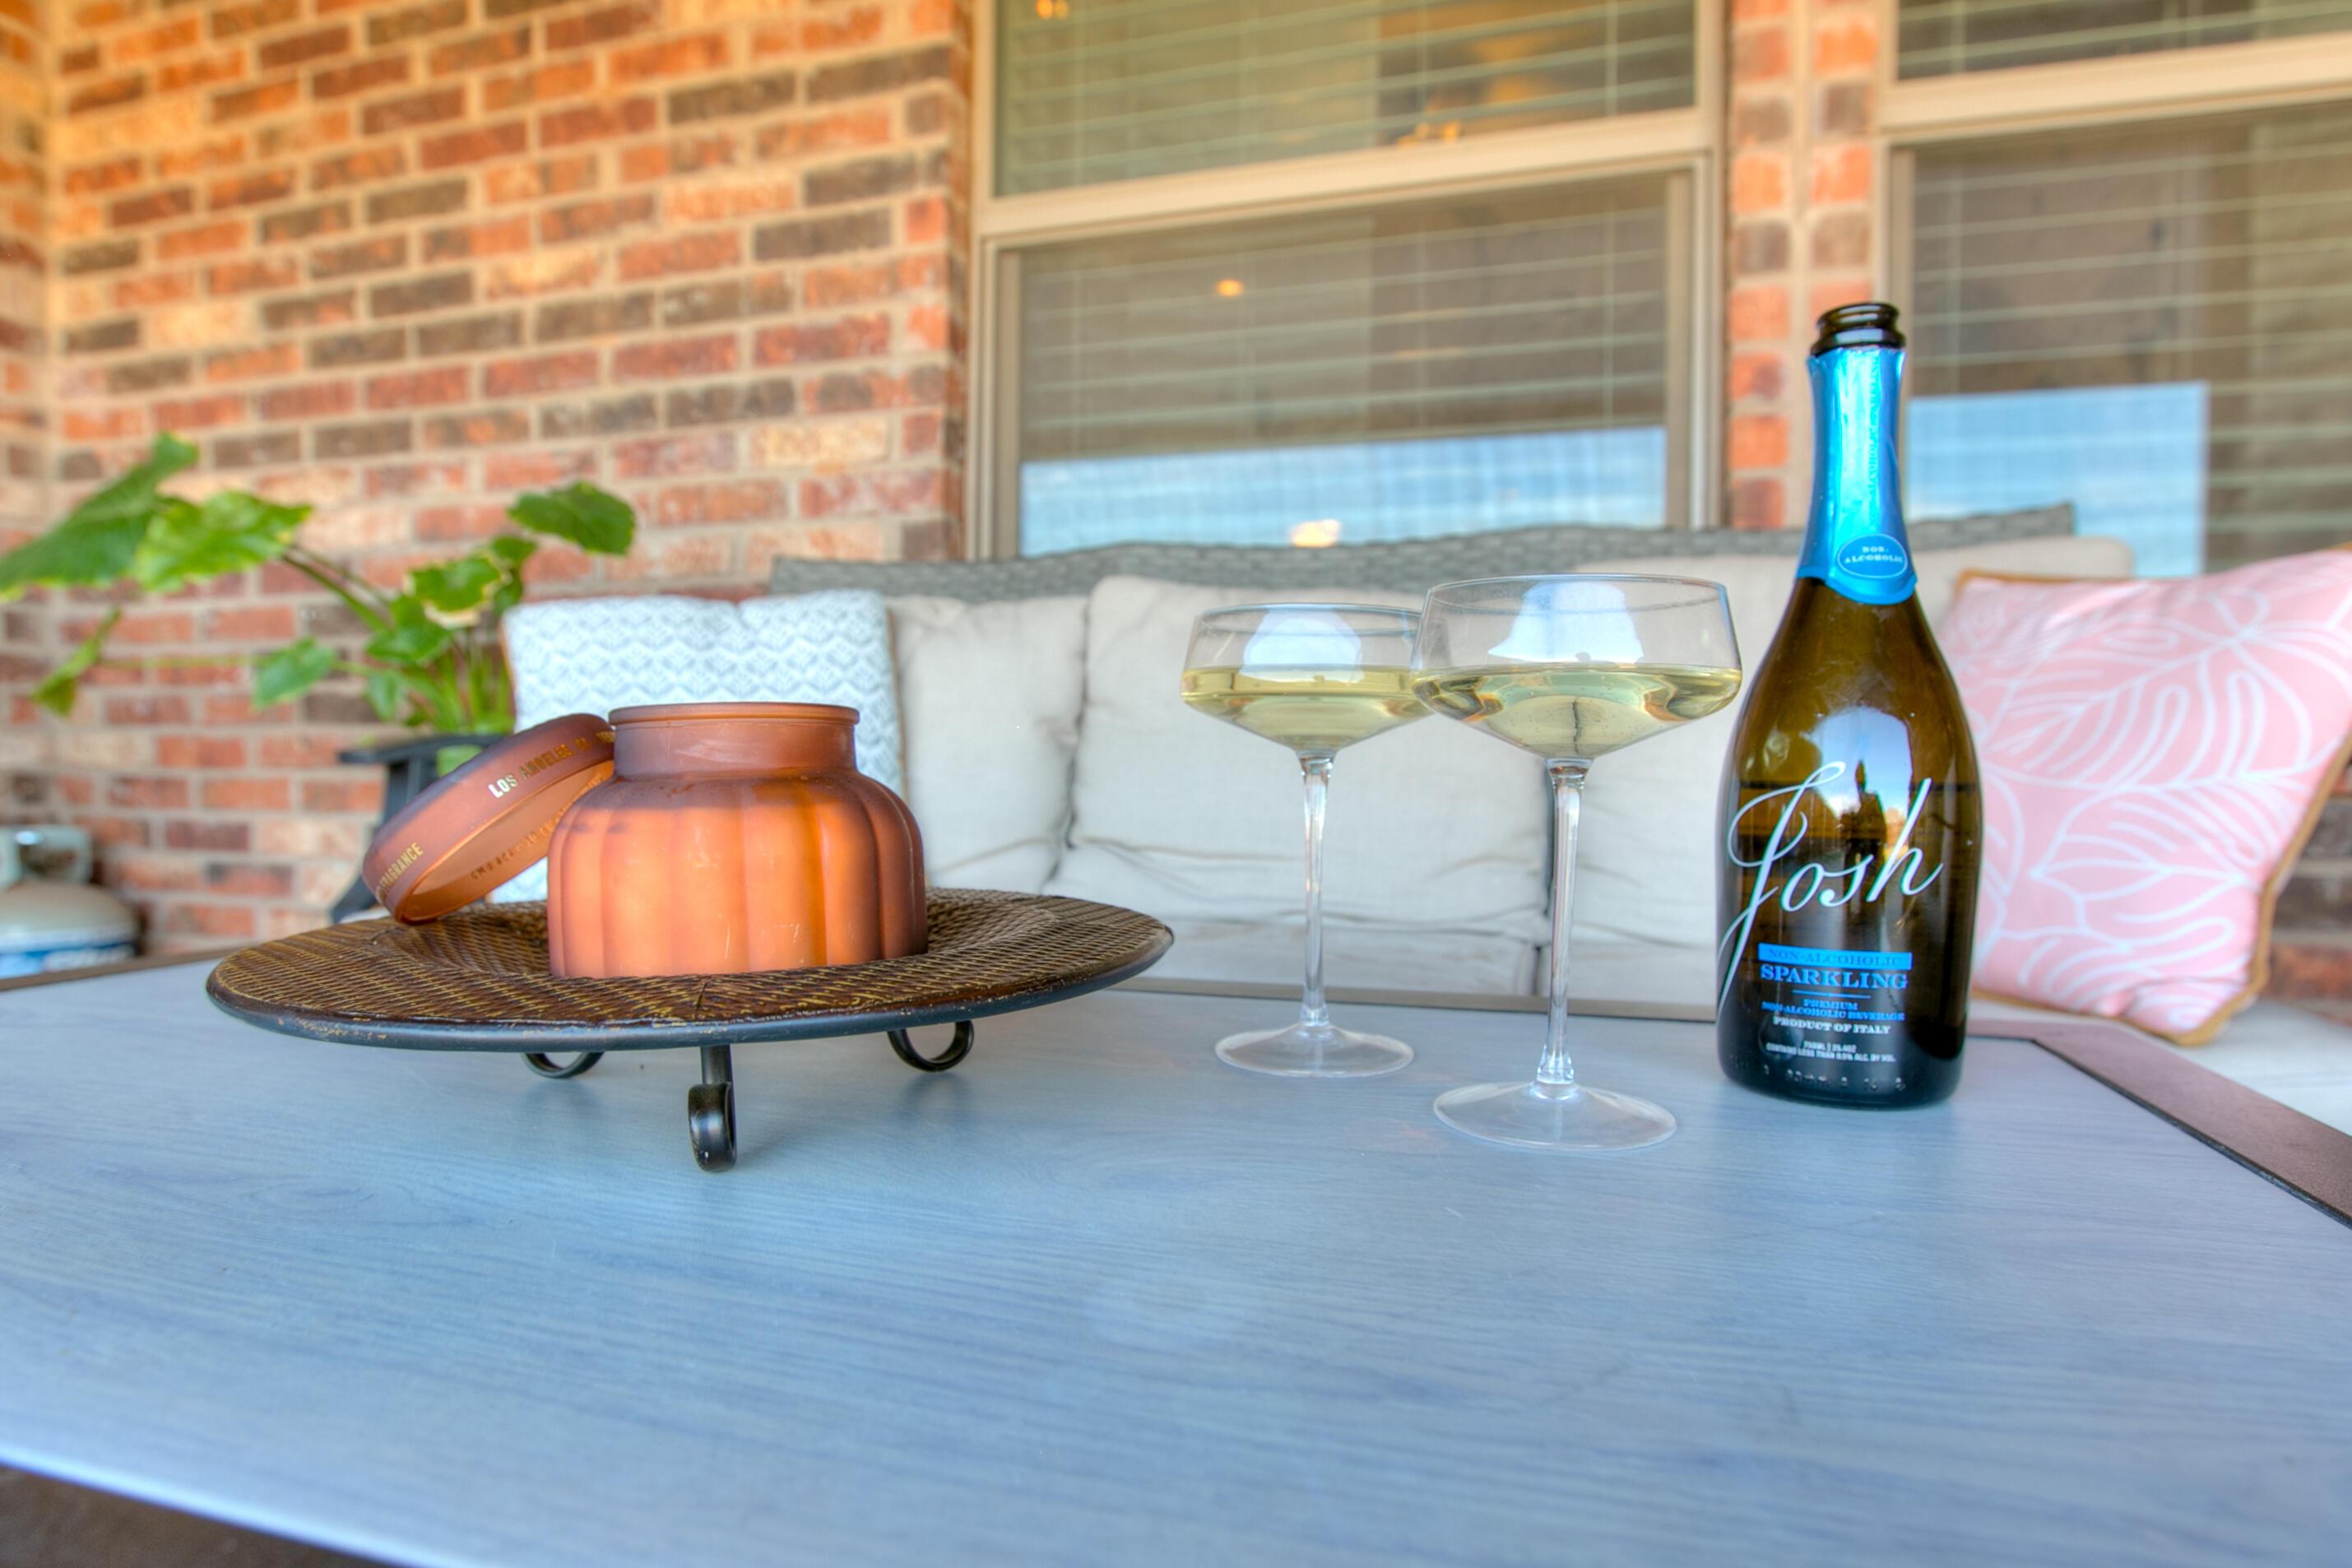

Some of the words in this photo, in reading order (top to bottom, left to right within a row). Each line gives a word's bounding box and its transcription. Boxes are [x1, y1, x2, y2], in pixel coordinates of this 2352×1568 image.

[1844, 554, 1903, 564] ALCOHOLIC
[487, 774, 518, 798] LOS
[378, 842, 424, 893] FRAGRANCE
[1715, 760, 1944, 1023] Josh
[1770, 948, 1902, 967] NON-ALCOHOLIC
[1760, 963, 1909, 989] SPARKLING
[1761, 1001, 1847, 1019] NON-ALCOHOLIC
[1848, 1011, 1906, 1022] BEVERAGE
[1802, 998, 1858, 1011] PREMIUM
[1773, 1015, 1831, 1032] PRODUCT
[1832, 1023, 1853, 1033] OF
[1853, 1024, 1892, 1035] ITALY
